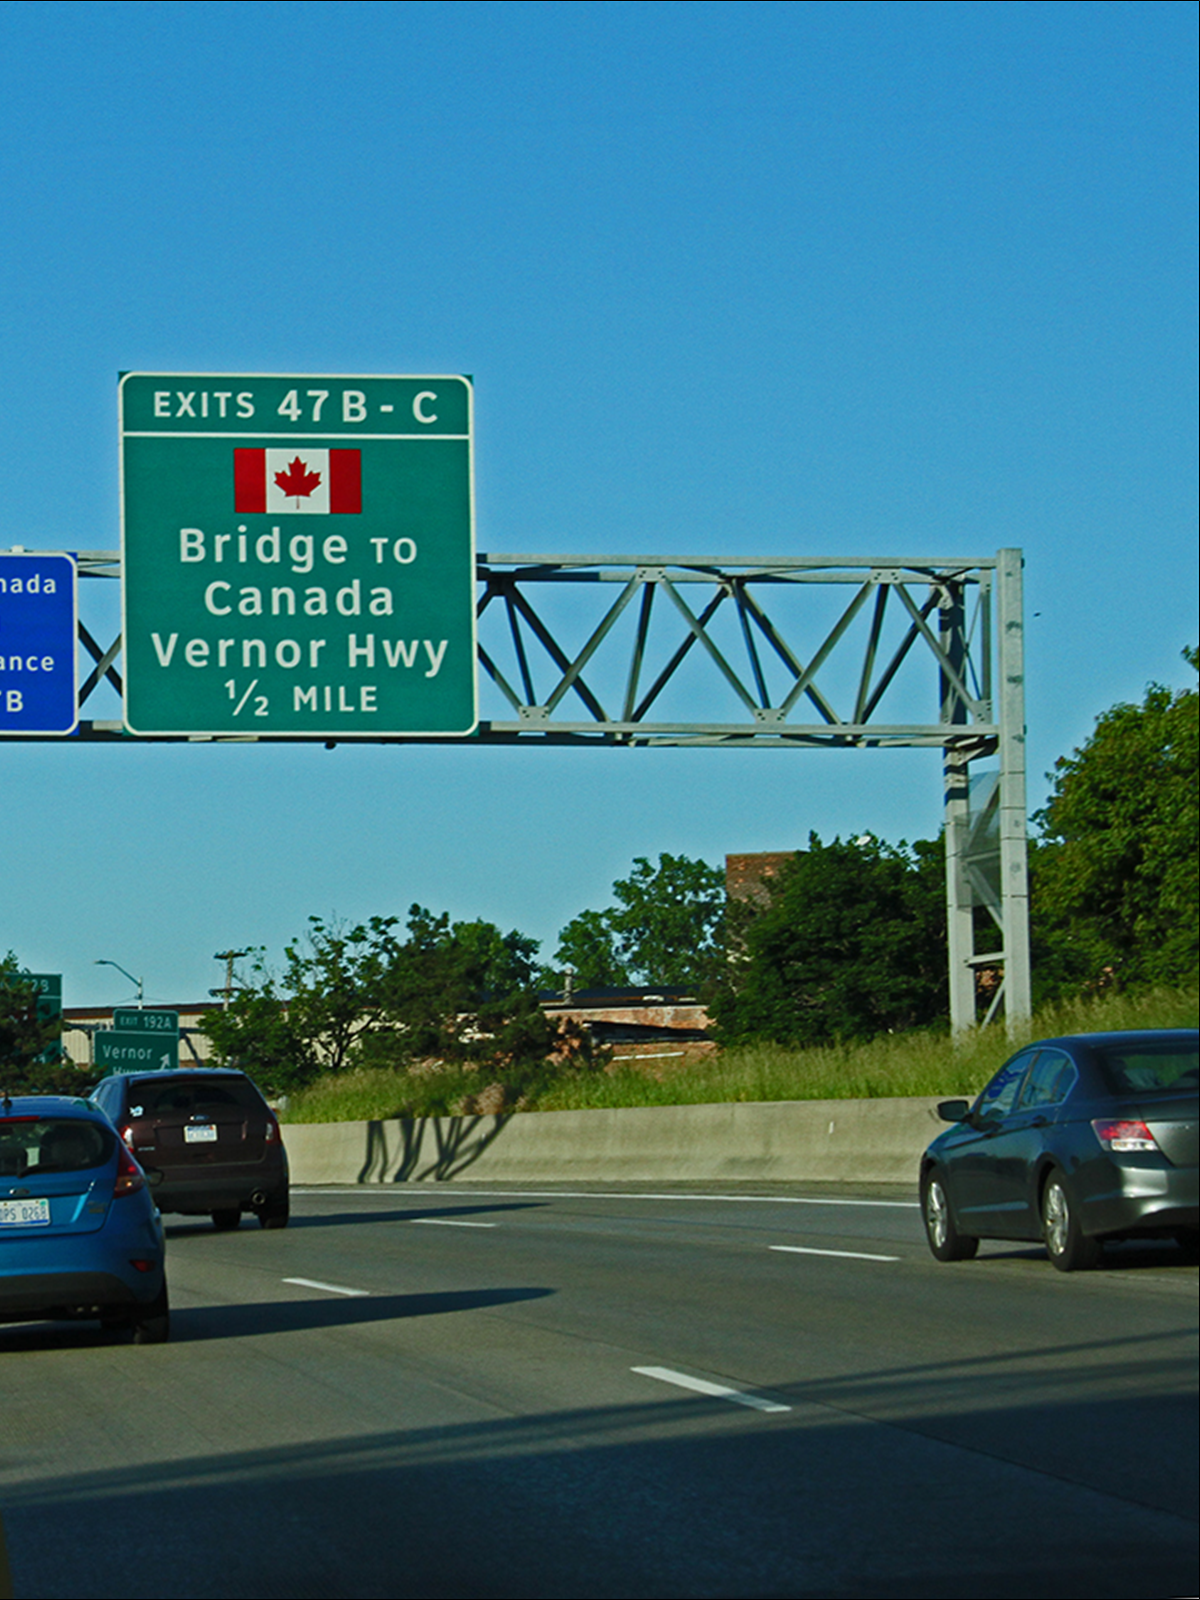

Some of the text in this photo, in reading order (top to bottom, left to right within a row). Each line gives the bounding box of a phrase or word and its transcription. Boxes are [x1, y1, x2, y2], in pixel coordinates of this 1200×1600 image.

[154, 391, 255, 418] EXITS
[180, 525, 417, 573] Bridge TO
[204, 579, 394, 616] Canada
[151, 632, 448, 678] Vernor Hwy
[293, 685, 378, 712] MILE
[120, 1015, 172, 1029] EXIT 192A
[102, 1044, 153, 1060] Vernor
